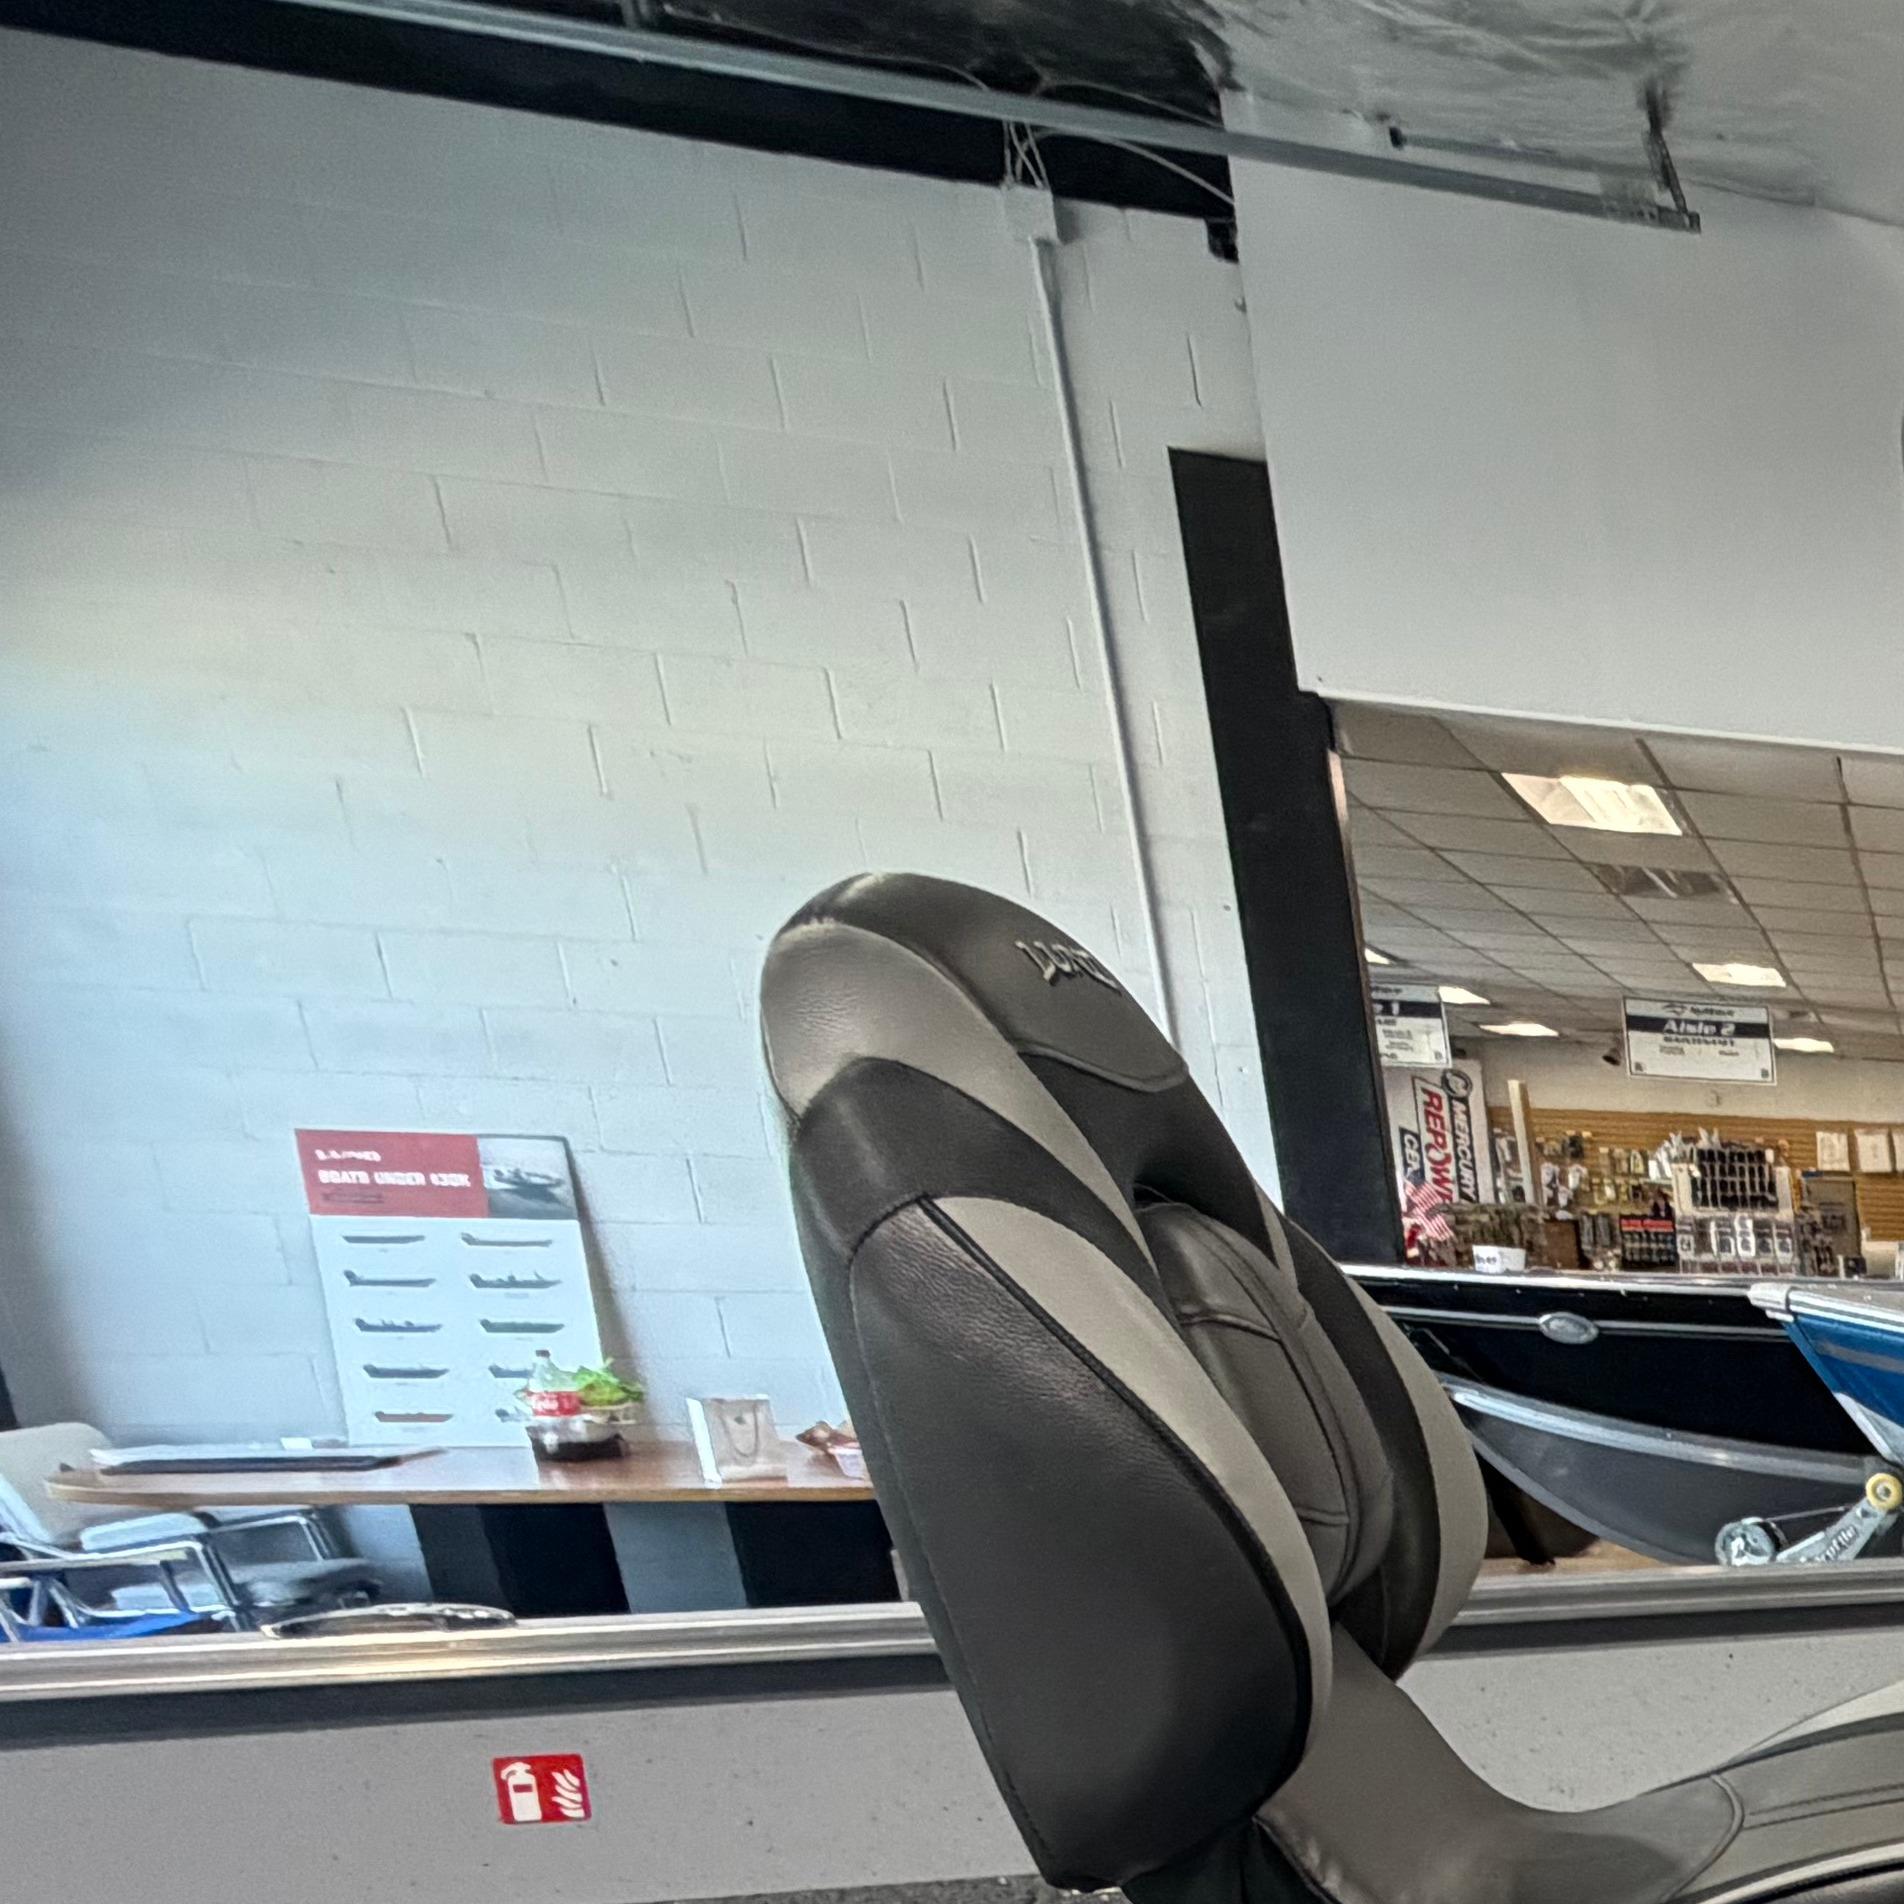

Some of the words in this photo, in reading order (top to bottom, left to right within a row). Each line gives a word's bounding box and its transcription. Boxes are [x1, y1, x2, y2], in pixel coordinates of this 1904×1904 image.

[1663, 1019, 1718, 1037] Aisle
[1720, 1022, 1736, 1037] 2
[1452, 1101, 1477, 1202] MERCURY
